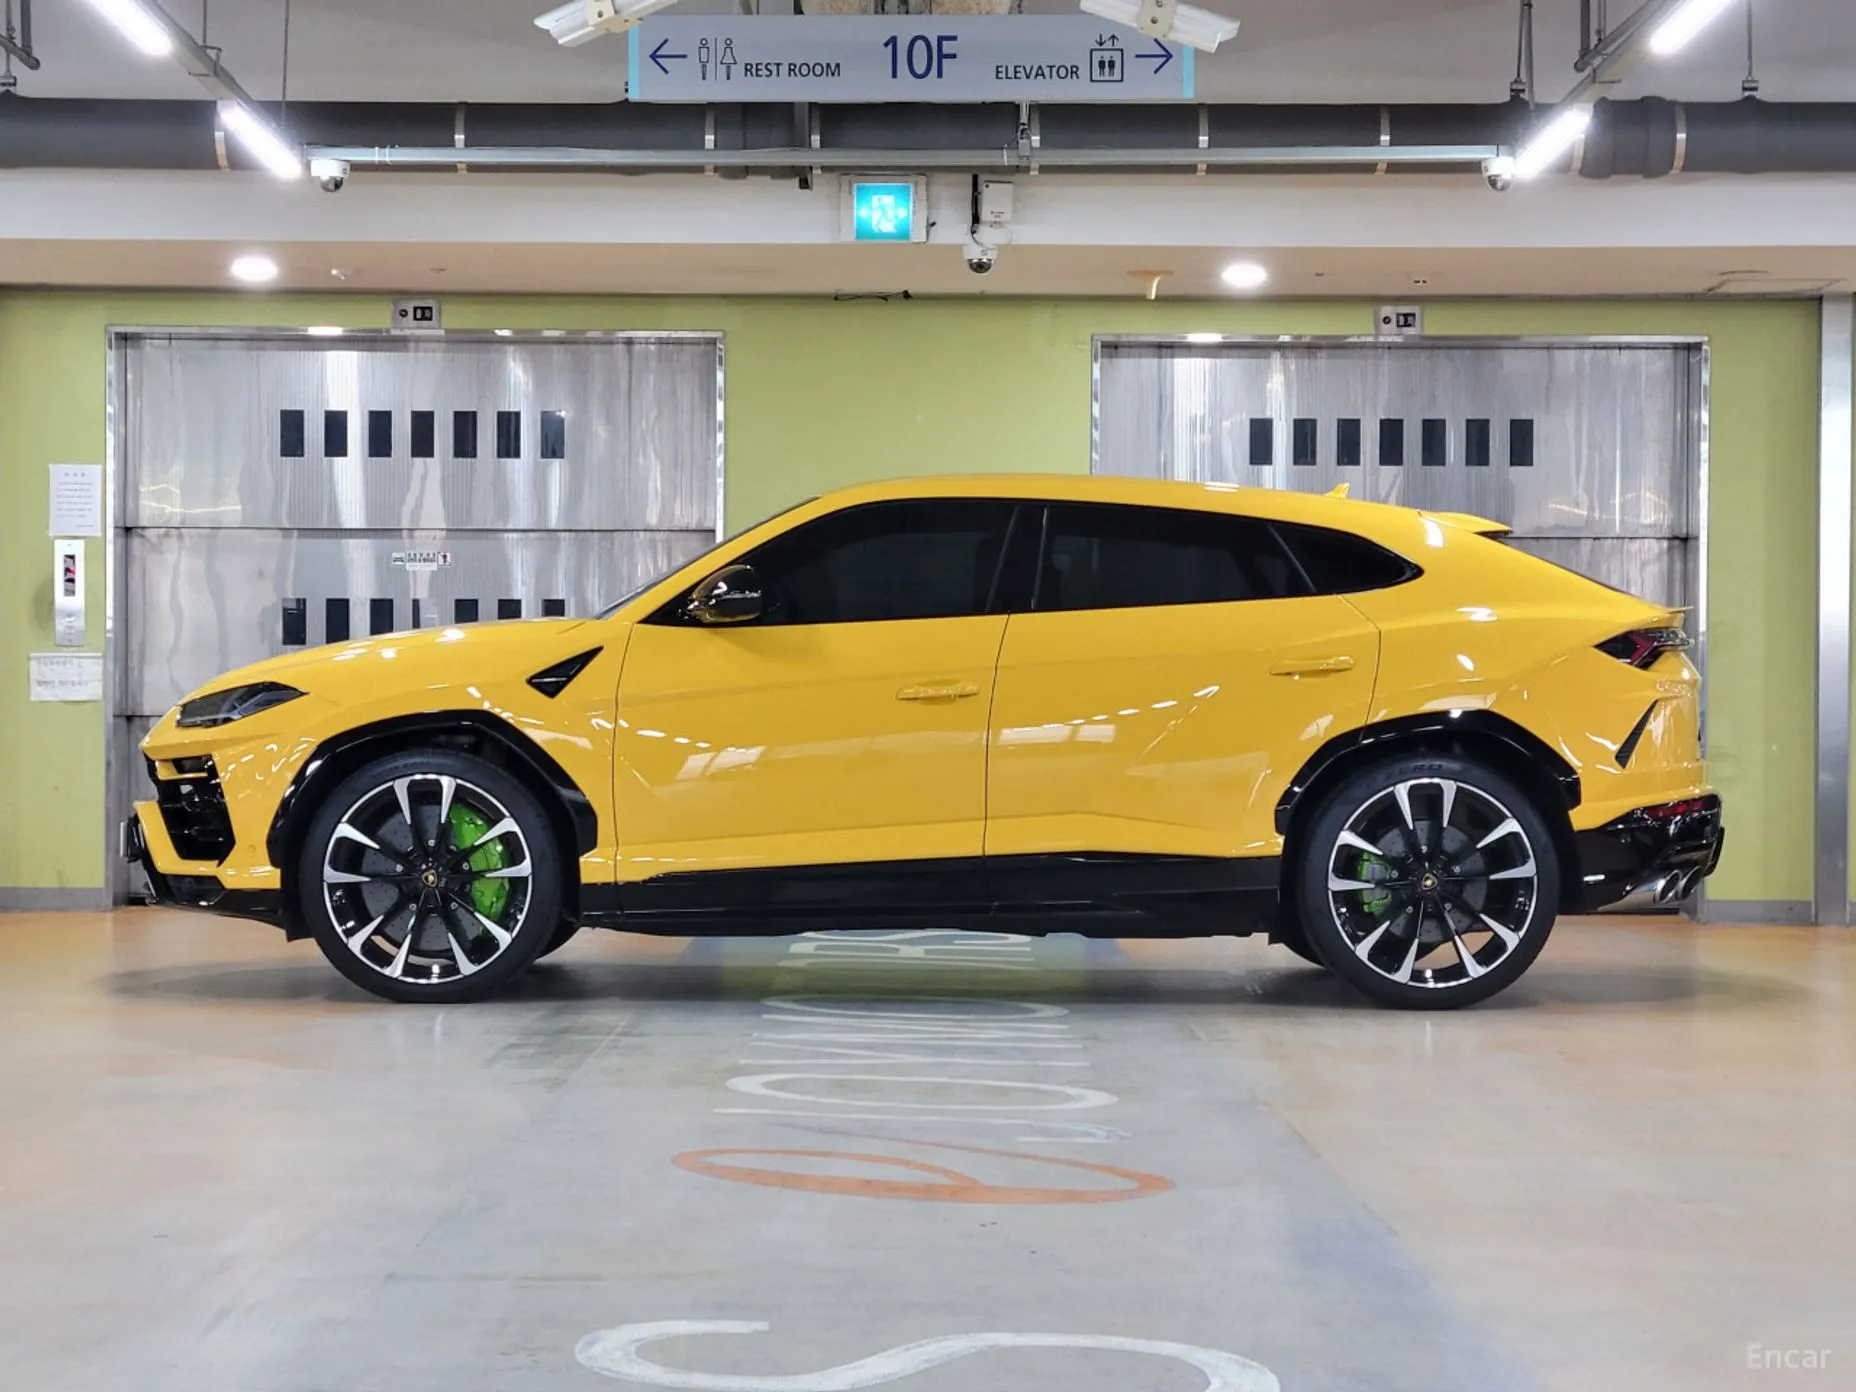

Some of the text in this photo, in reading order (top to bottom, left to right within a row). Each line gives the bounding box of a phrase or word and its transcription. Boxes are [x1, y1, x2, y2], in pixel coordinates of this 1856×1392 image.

[883, 34, 958, 80] 10F
[744, 62, 841, 78] REST ROOM
[995, 65, 1080, 80] ELEVATOR
